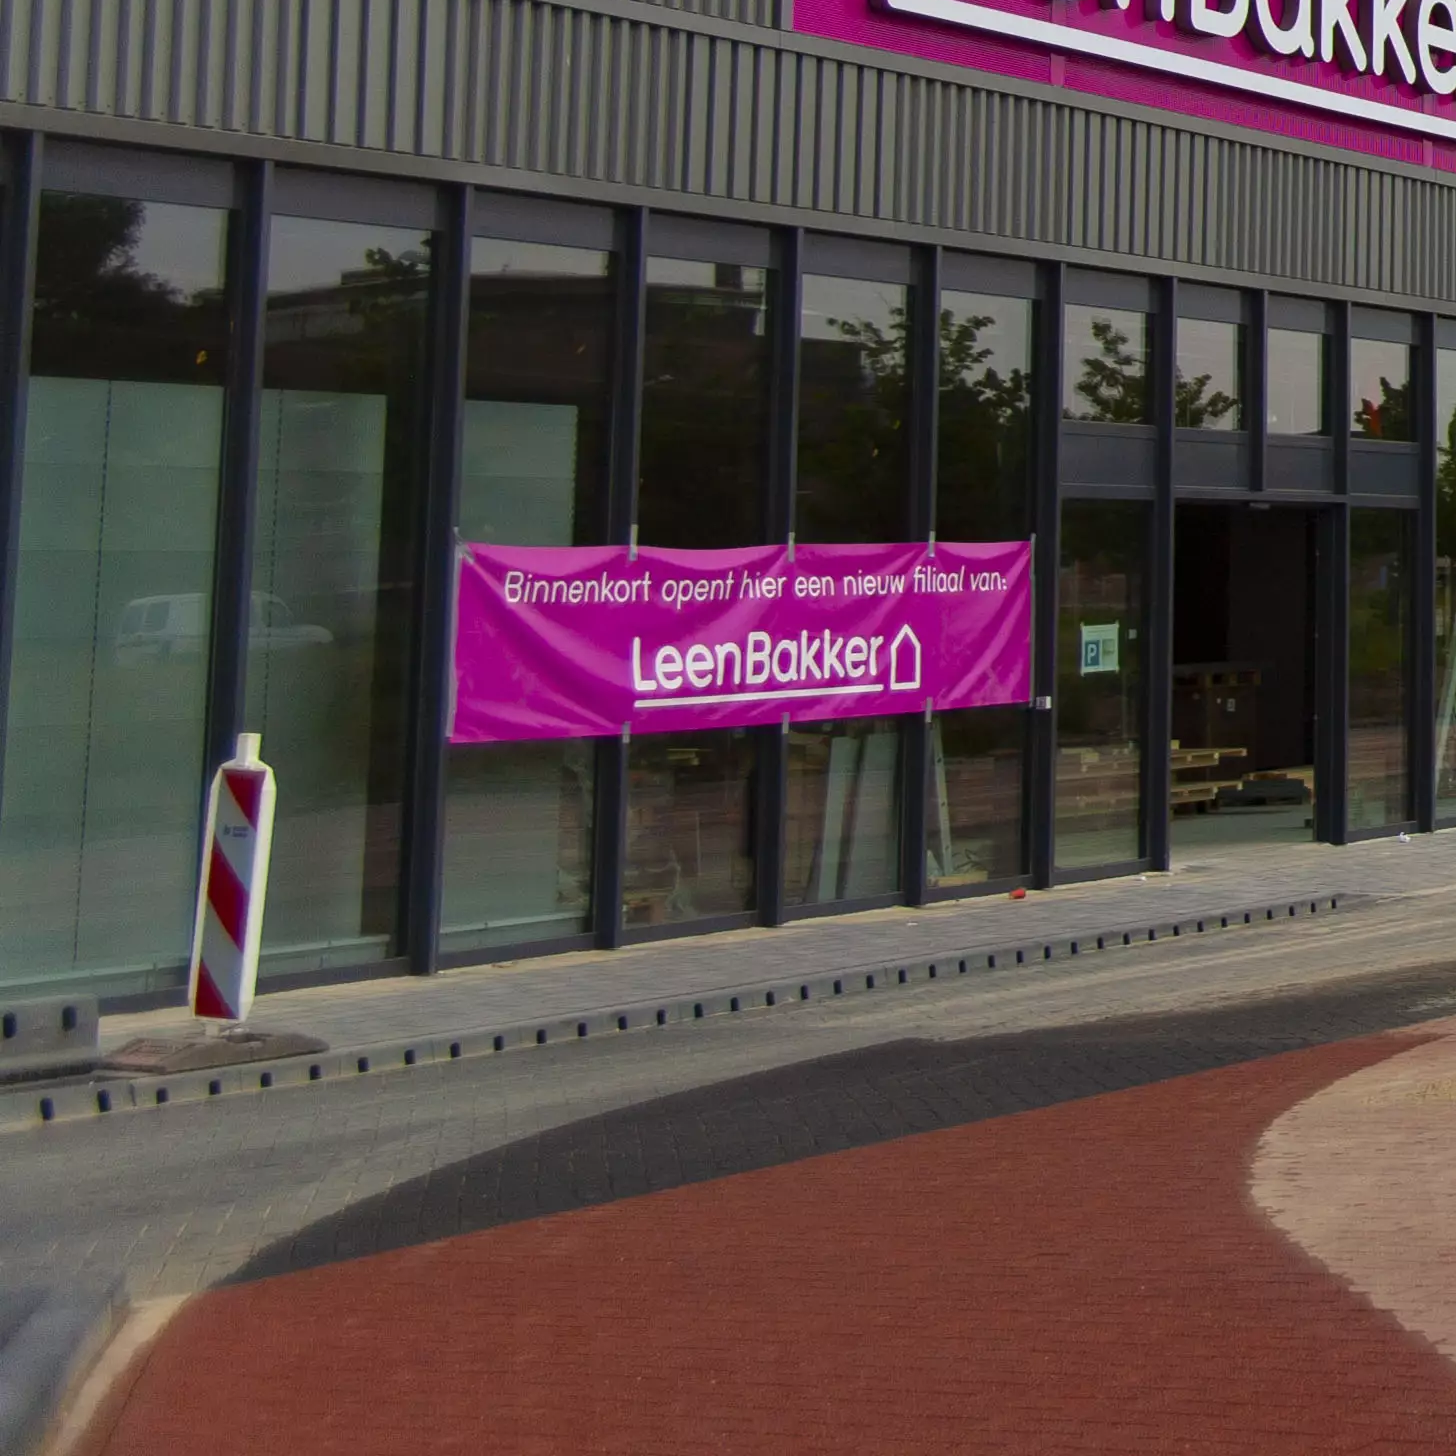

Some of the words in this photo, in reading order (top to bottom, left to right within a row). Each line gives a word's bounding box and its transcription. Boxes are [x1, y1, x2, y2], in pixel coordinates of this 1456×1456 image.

[504, 570, 651, 603] Binnenkort
[661, 570, 734, 610] opent
[740, 570, 787, 599] hier
[794, 575, 835, 597] een
[843, 570, 905, 596] nieuw
[913, 565, 965, 593] filiaal
[970, 571, 1008, 592] van:
[632, 629, 884, 691] LeenBakker
